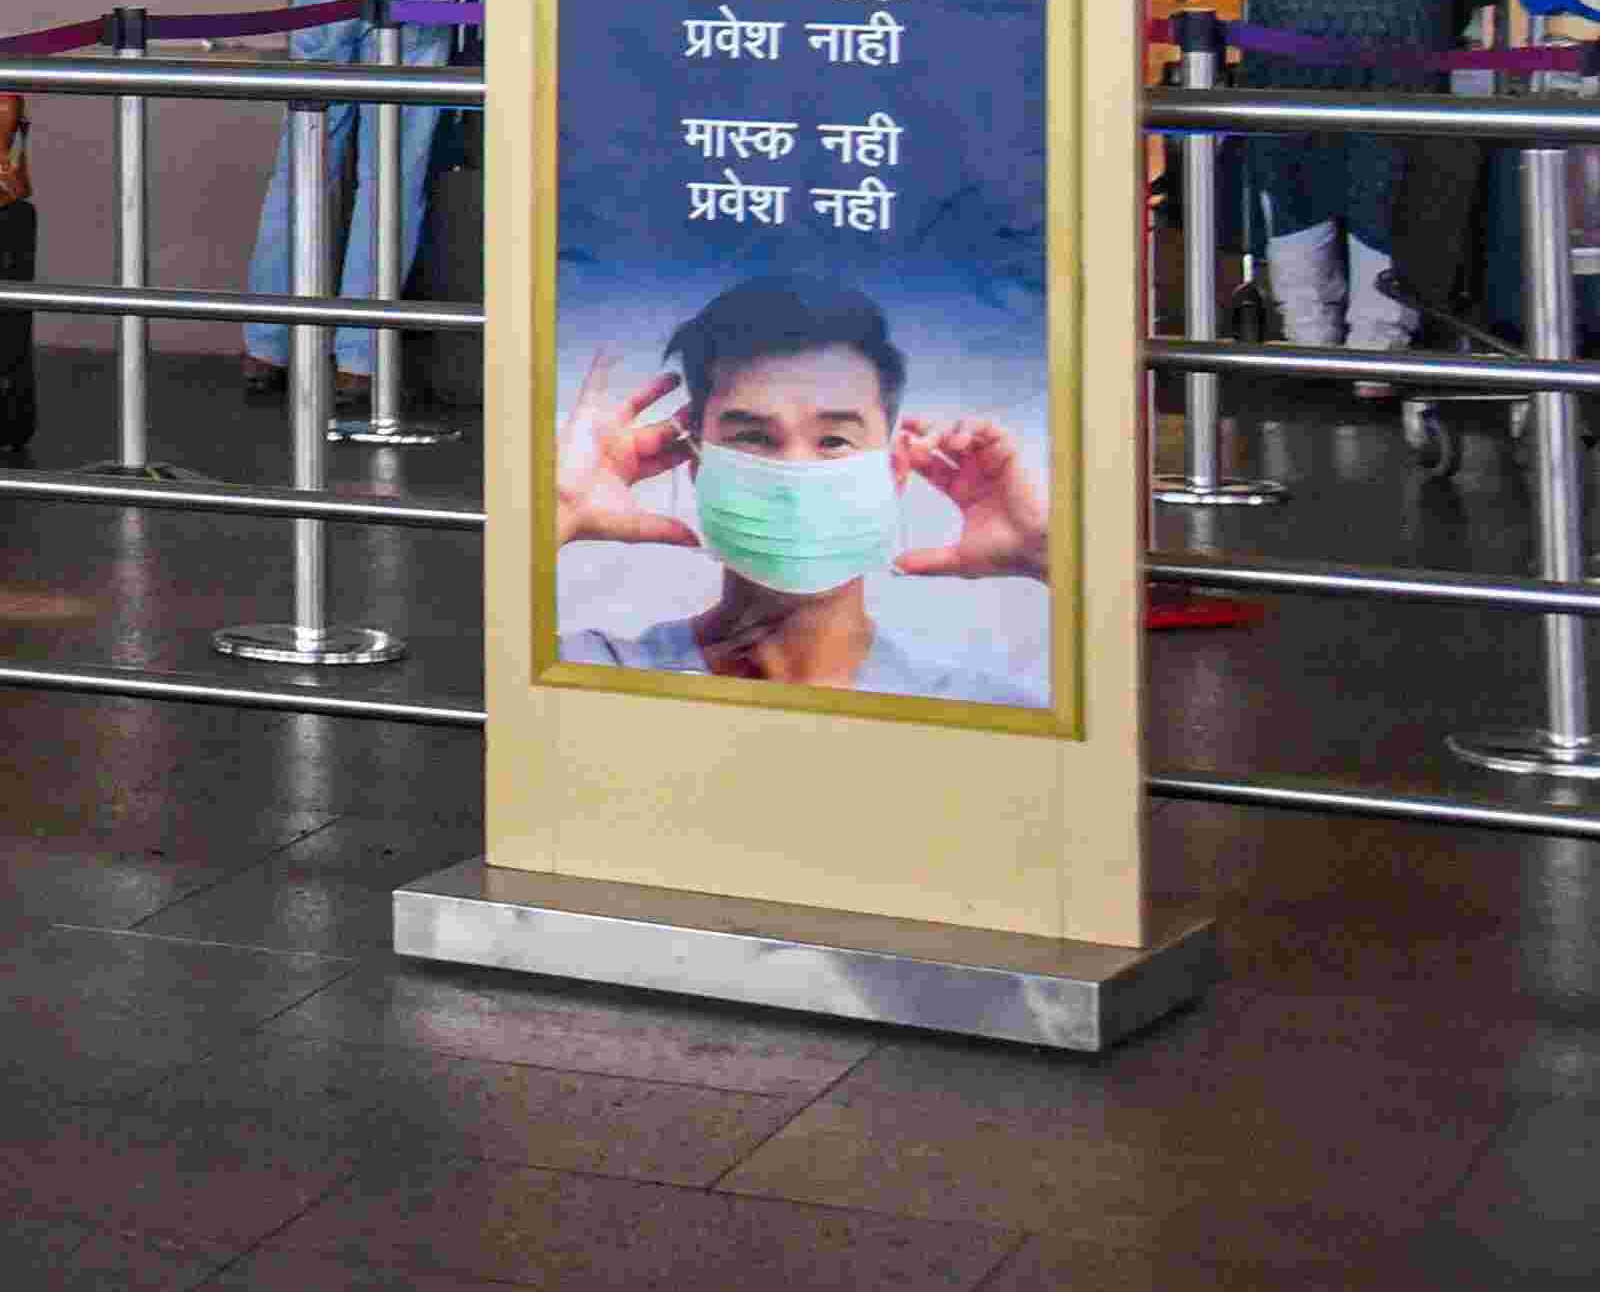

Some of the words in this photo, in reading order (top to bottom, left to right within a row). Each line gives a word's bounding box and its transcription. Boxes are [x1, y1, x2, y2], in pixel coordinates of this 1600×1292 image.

[681, 4, 788, 60] प्रवेश
[804, 10, 905, 66] नाही
[680, 118, 800, 159] मास्क
[816, 111, 905, 166] नही
[685, 167, 792, 224] प्रवेश
[809, 175, 897, 232] नही
